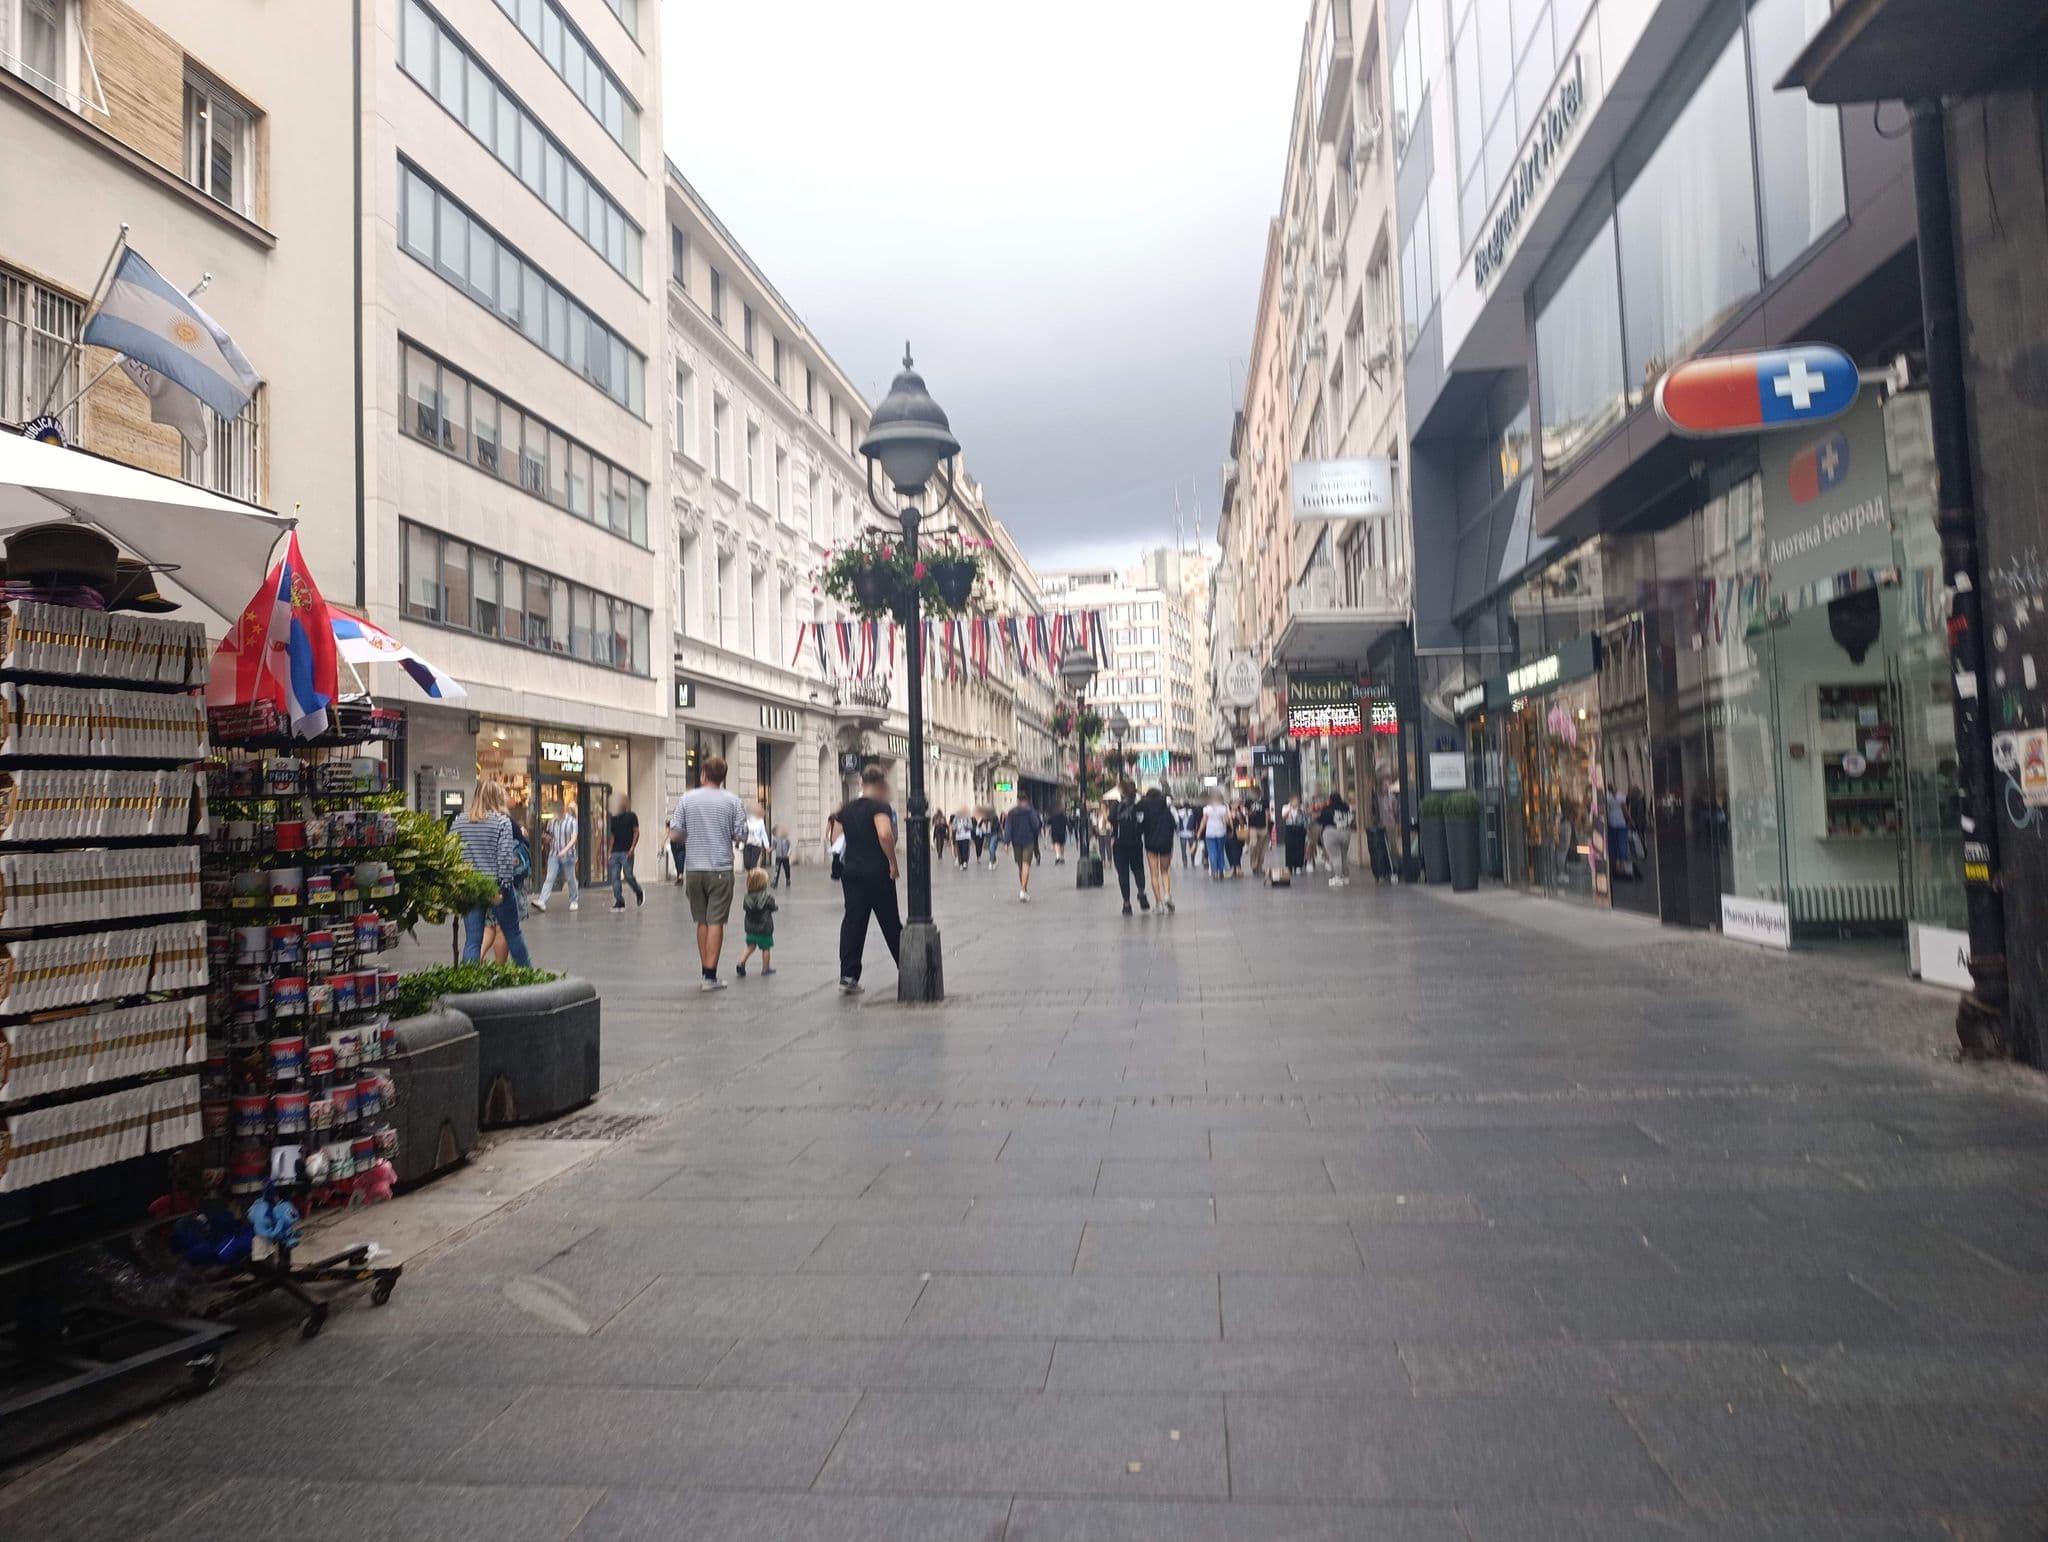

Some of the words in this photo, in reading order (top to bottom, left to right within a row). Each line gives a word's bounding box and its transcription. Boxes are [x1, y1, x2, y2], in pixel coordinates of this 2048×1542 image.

[1519, 141, 1543, 209] Art
[1541, 53, 1584, 167] Hotel
[1771, 524, 1821, 565] Апотека
[1822, 496, 1885, 543] Београд
[1262, 753, 1284, 765] LUNA
